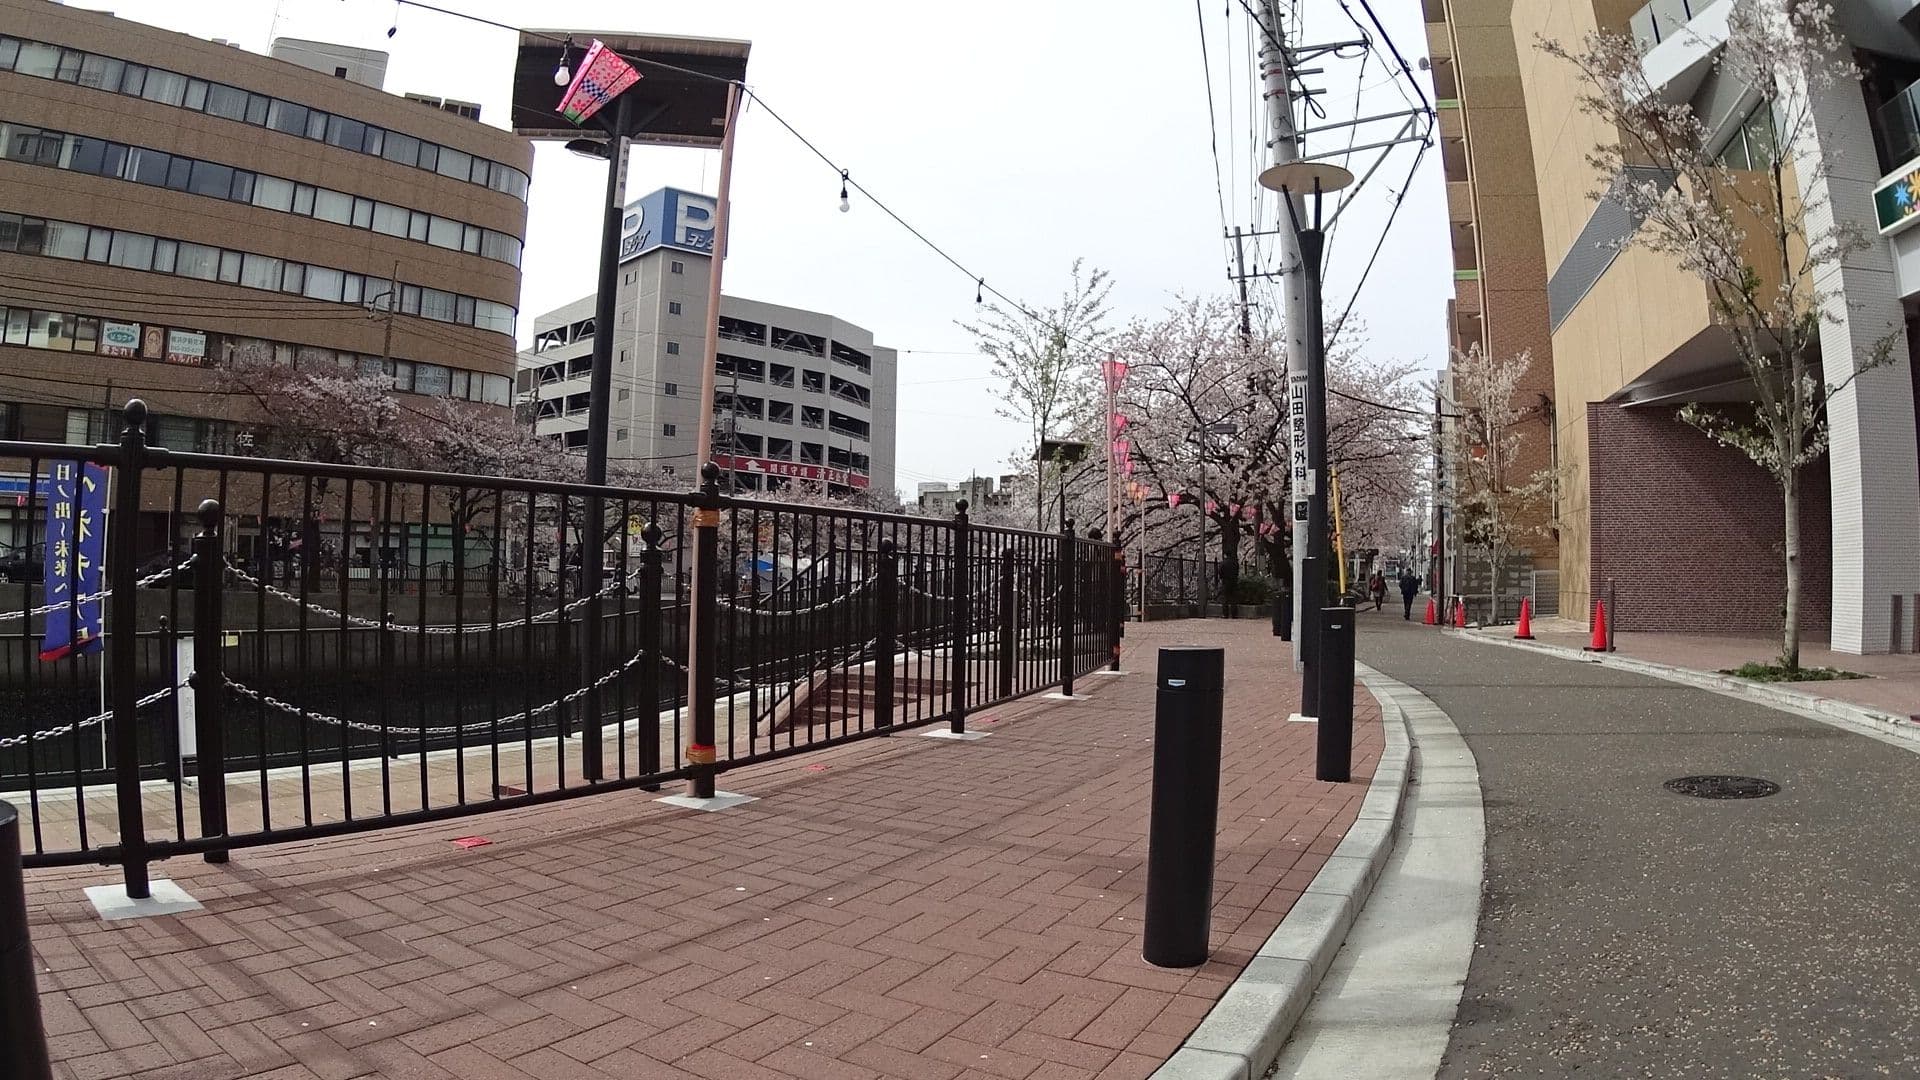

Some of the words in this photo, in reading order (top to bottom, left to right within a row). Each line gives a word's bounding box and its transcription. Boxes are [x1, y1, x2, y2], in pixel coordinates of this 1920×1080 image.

[676, 193, 716, 245] P
[1291, 385, 1307, 481] 山田整形外科
